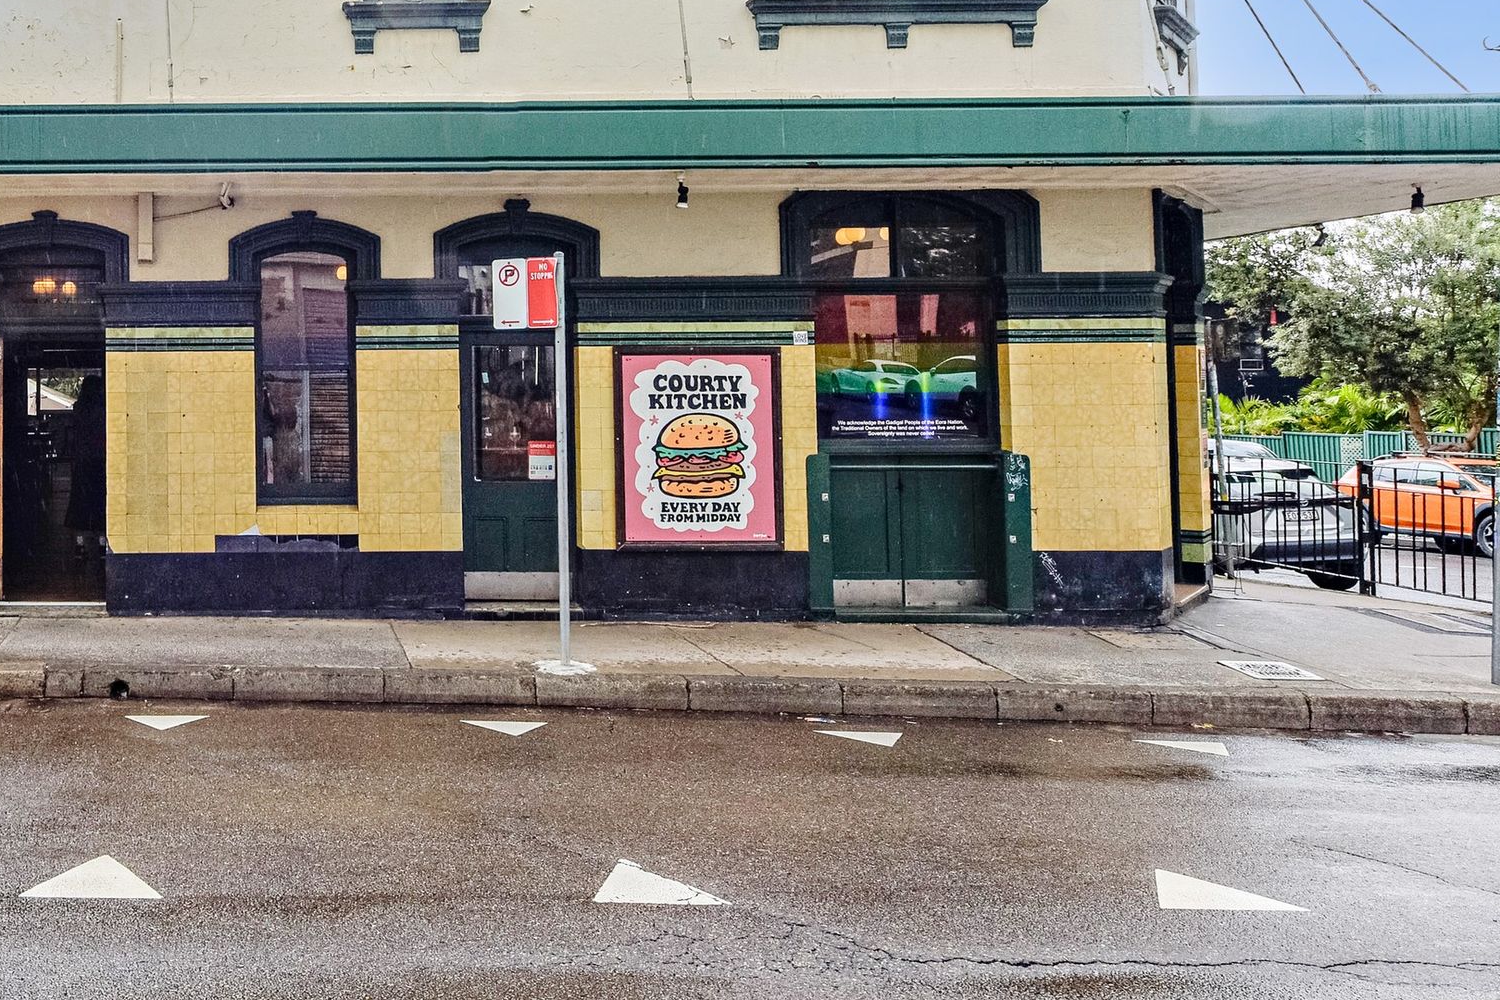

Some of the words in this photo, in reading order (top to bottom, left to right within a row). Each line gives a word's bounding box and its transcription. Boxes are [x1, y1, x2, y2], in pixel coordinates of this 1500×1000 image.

[653, 374, 742, 393] COURTY
[648, 393, 747, 410] KITCHEN
[661, 502, 709, 513] EVERY
[712, 502, 741, 513] DAY
[660, 513, 694, 523] FROM
[696, 513, 741, 523] MIDDAY
